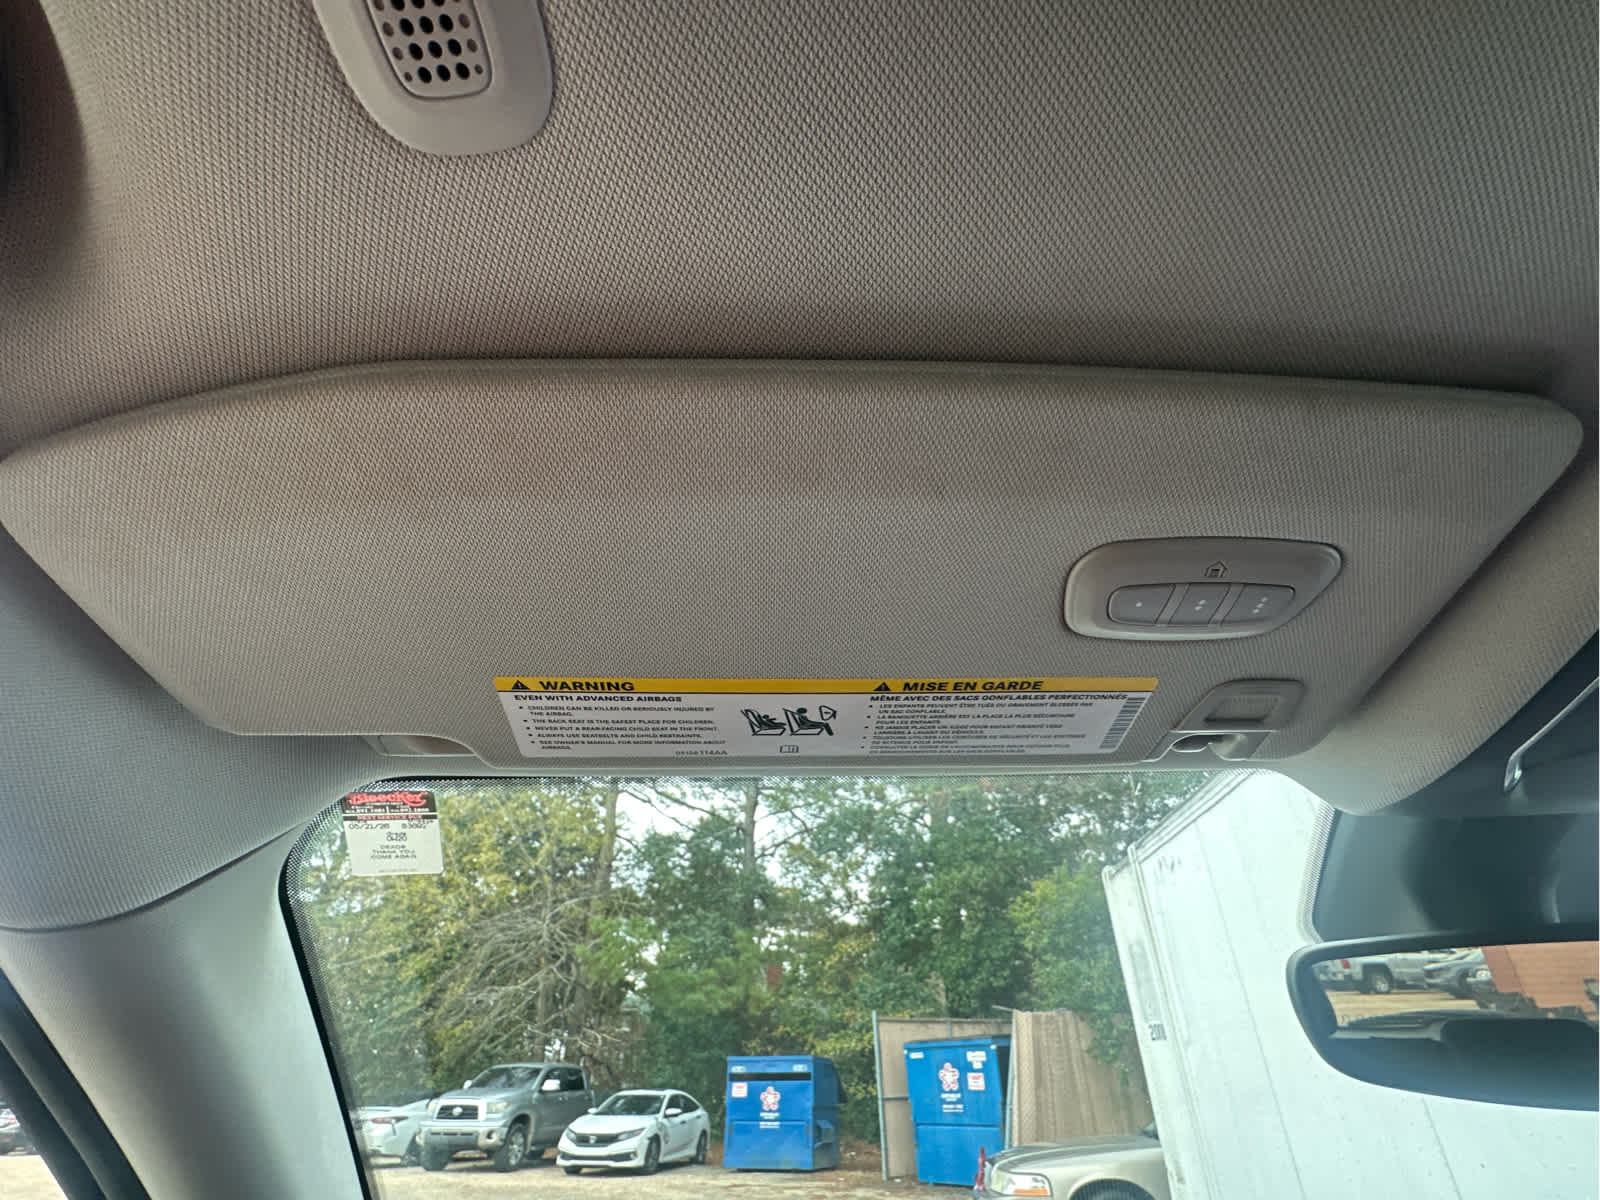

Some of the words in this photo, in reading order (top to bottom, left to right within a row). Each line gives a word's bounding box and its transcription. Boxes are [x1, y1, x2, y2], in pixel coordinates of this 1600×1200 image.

[539, 680, 635, 691] WARNING
[902, 681, 948, 691] MISE
[951, 681, 977, 691] EN
[981, 681, 1044, 691] GARDE
